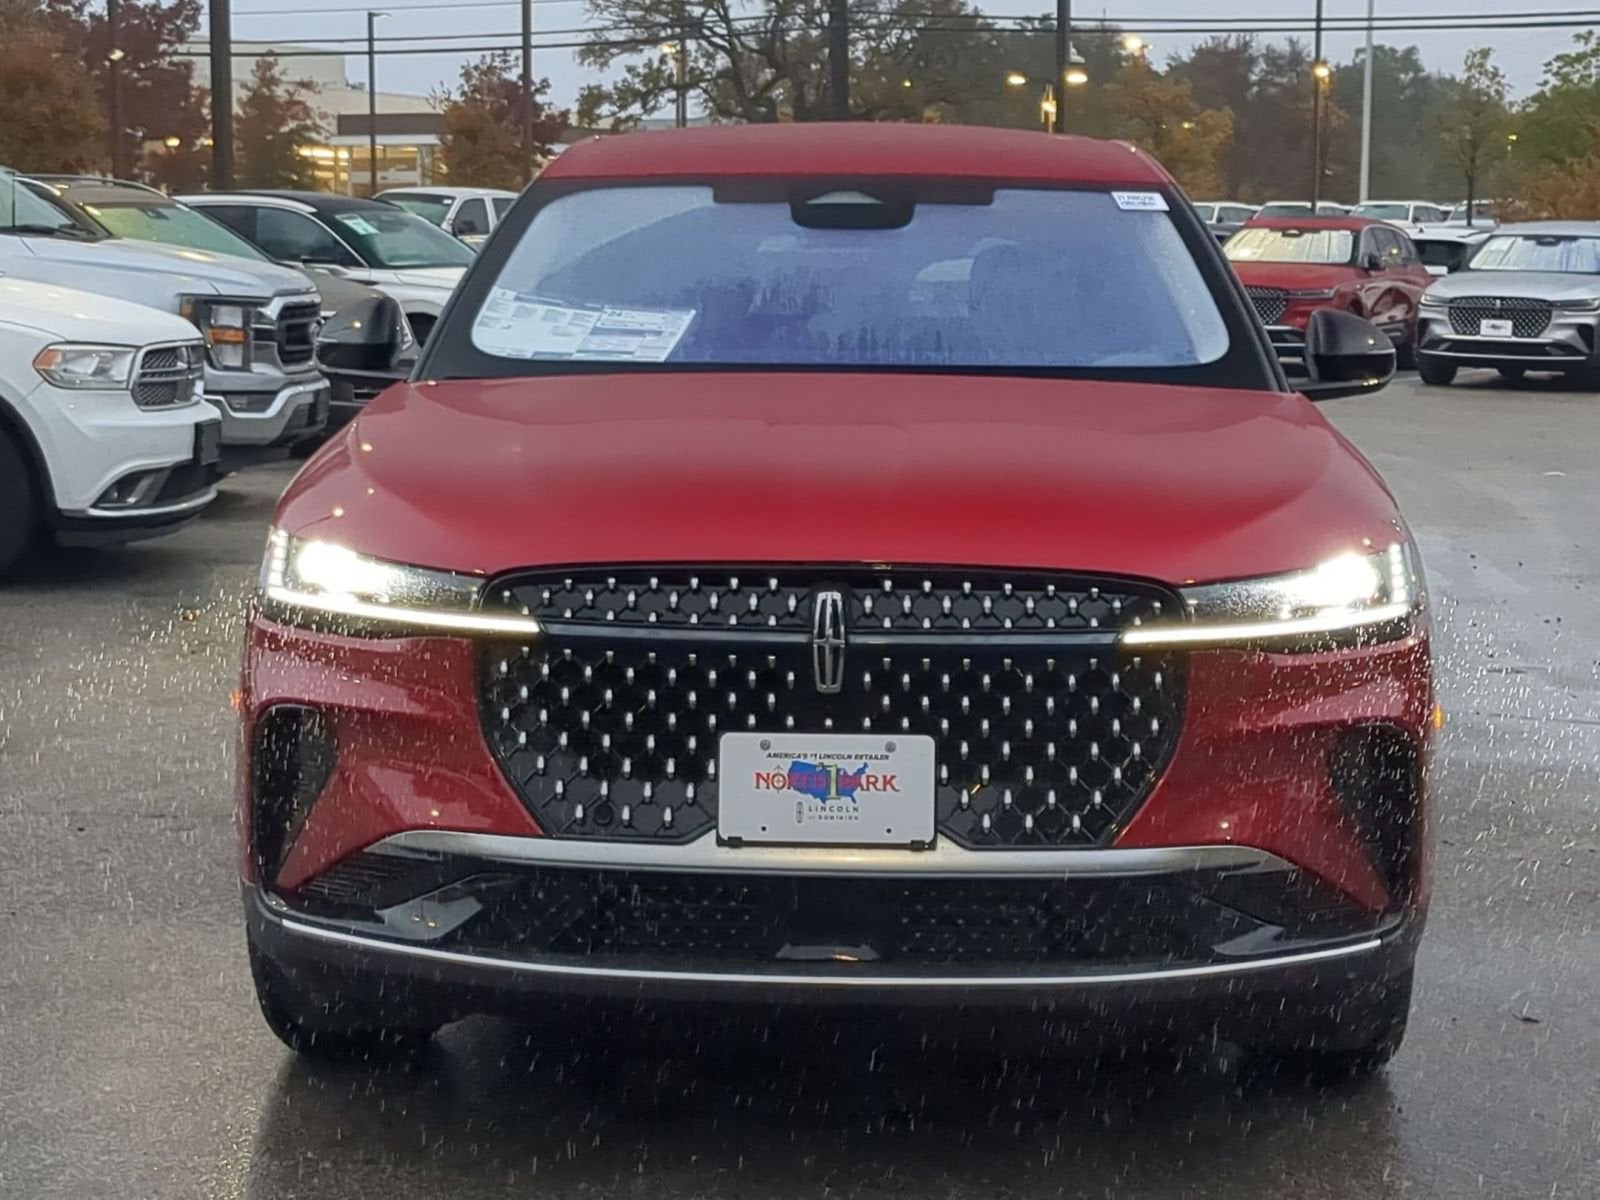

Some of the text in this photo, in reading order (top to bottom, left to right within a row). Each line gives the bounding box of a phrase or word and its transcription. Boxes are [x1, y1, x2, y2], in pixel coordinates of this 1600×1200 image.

[766, 752, 808, 760] AMERICA'S
[819, 753, 853, 761] LINCOLN
[808, 805, 859, 813] LINCOLN
